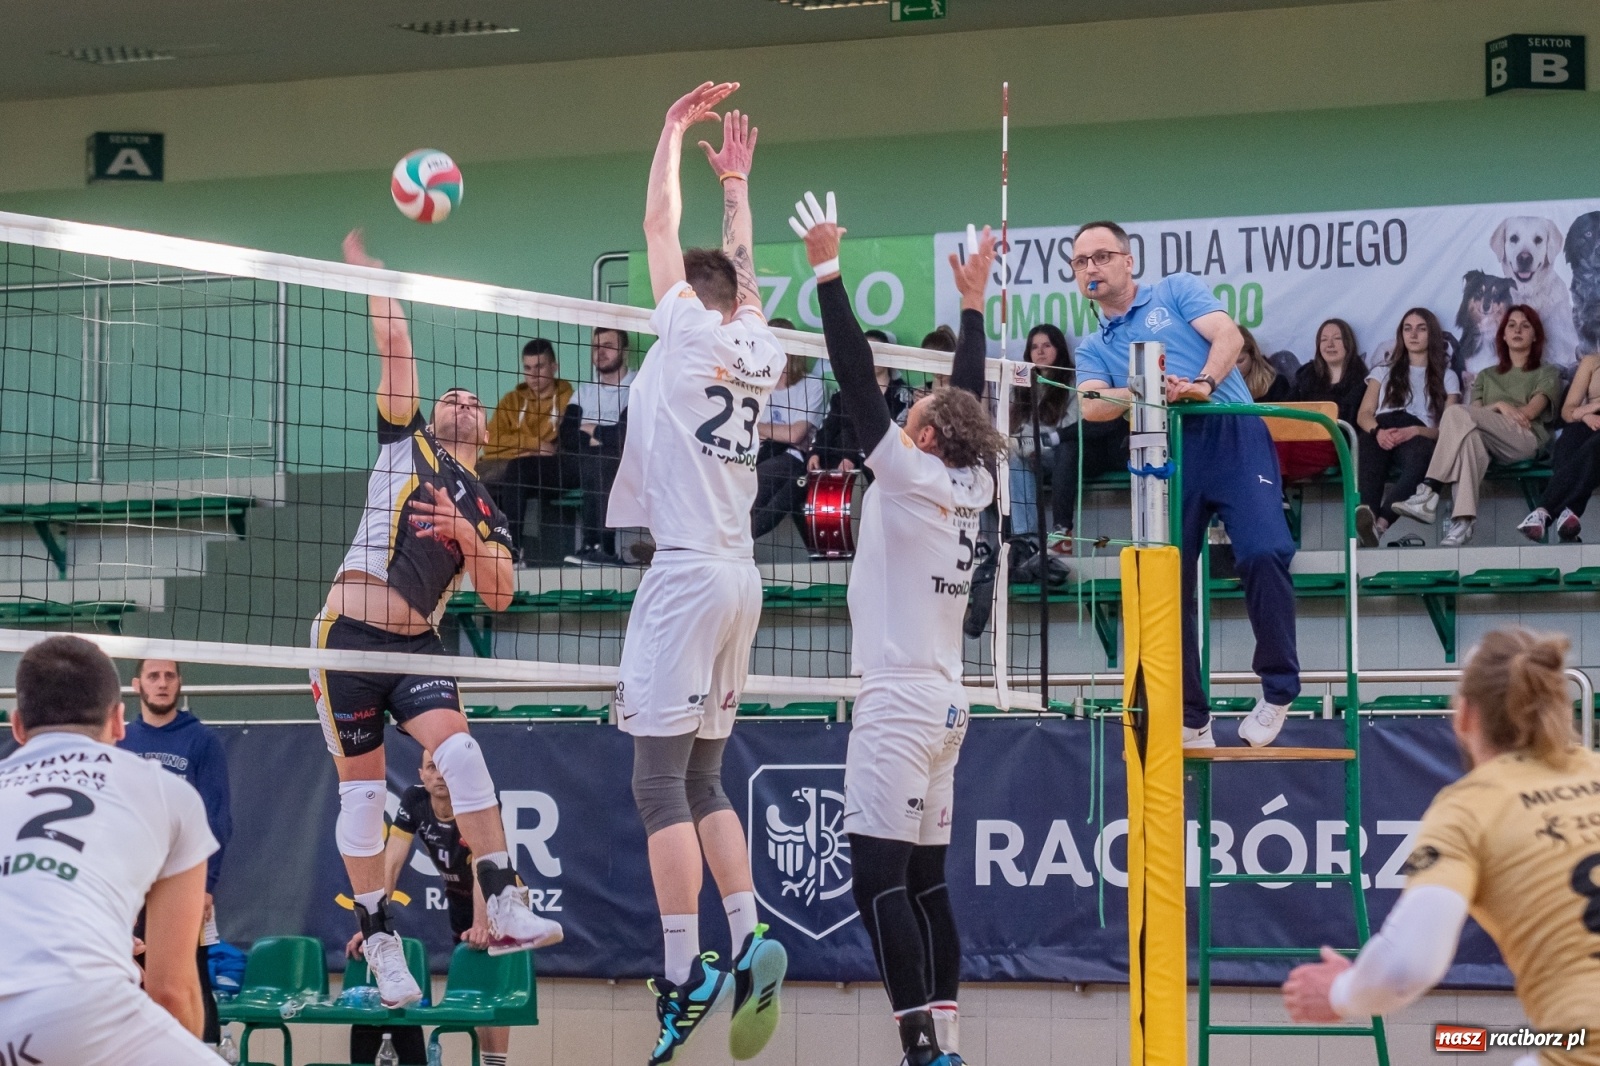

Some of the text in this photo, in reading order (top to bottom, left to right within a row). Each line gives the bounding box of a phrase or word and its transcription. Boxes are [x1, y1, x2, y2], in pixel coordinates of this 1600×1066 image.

[1528, 37, 1572, 48] SEKTOR
[1491, 56, 1508, 89] B
[1531, 52, 1570, 84] B
[106, 148, 152, 176] A
[1161, 228, 1226, 275] DLA
[1238, 218, 1408, 274] TWOJEGO
[695, 385, 760, 455] 23
[956, 529, 974, 571] 5
[410, 679, 454, 694] GRAYTON
[16, 786, 95, 853] 2
[975, 793, 1423, 889] RACBÓRZ
[0, 852, 79, 882] iDog
[437, 849, 450, 868] 4
